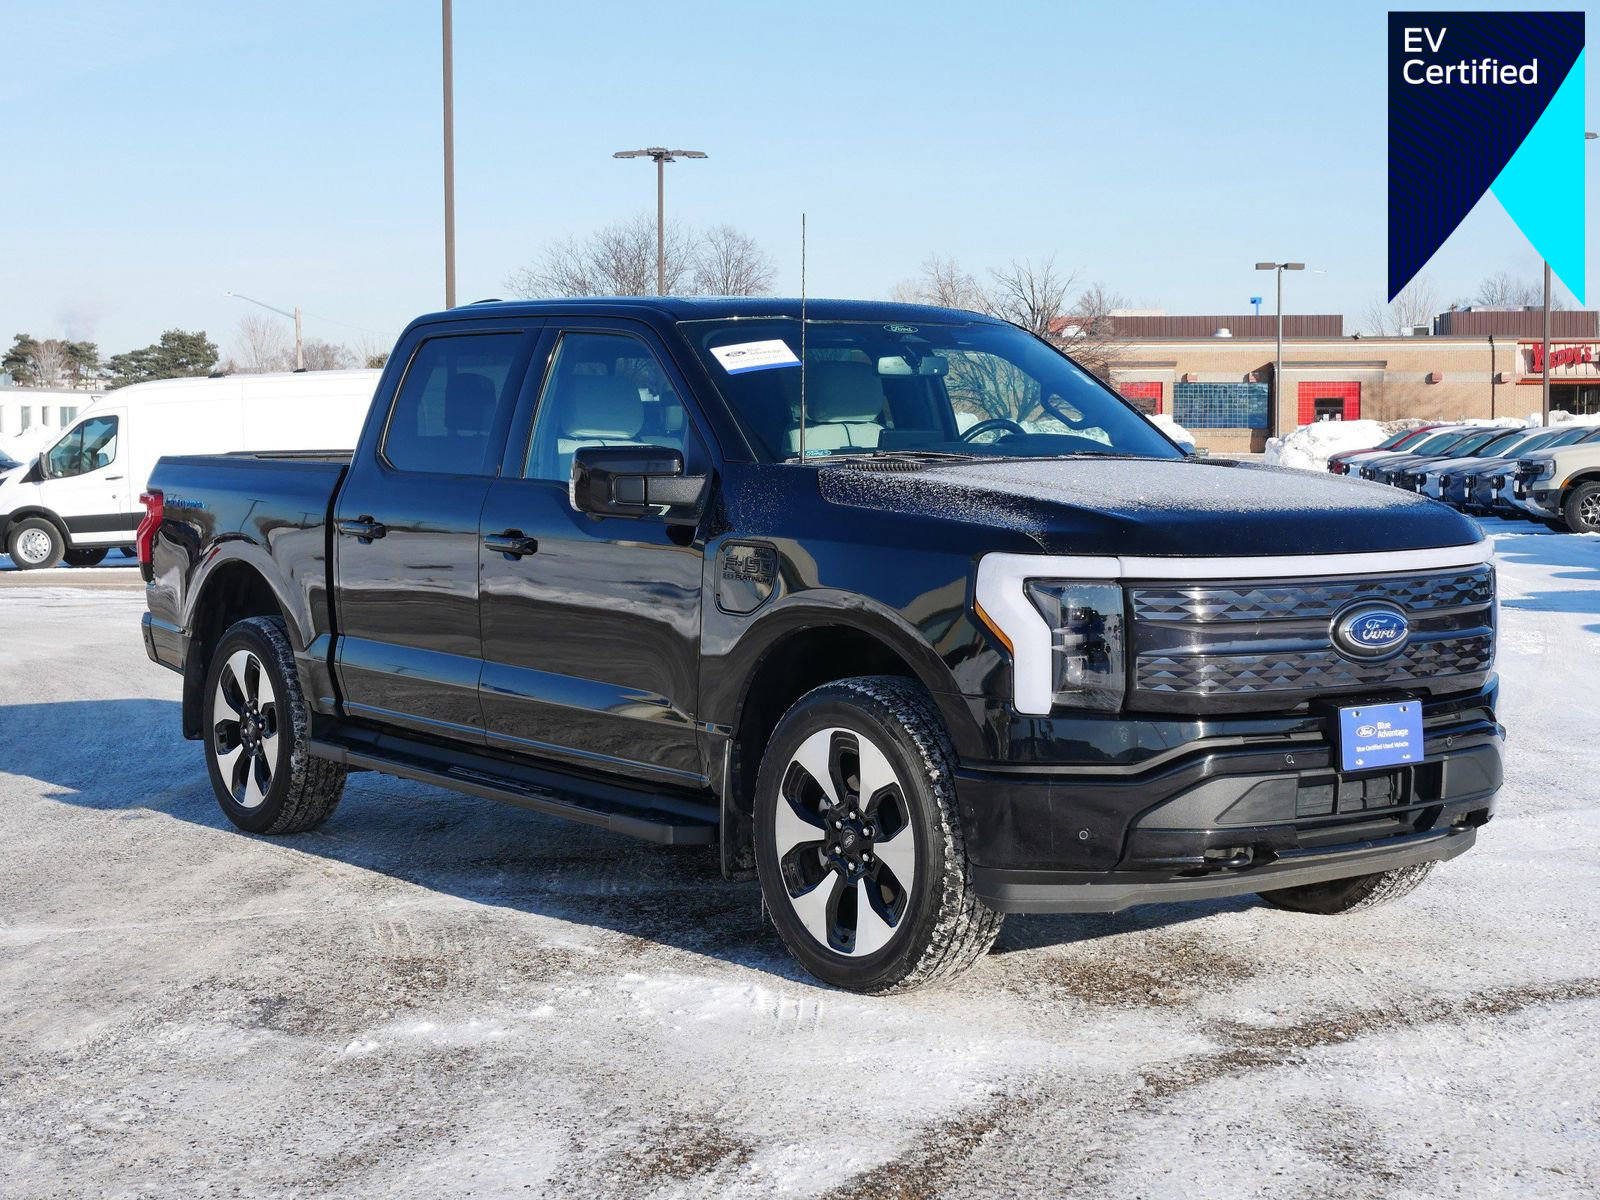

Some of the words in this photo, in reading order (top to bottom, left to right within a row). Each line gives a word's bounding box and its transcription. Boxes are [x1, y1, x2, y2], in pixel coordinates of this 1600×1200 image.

[723, 555, 774, 576] F-150
[735, 574, 770, 584] PLATINUM
[1362, 618, 1397, 640] Ford
[1377, 721, 1392, 730] Blue
[1377, 728, 1409, 738] Advantage
